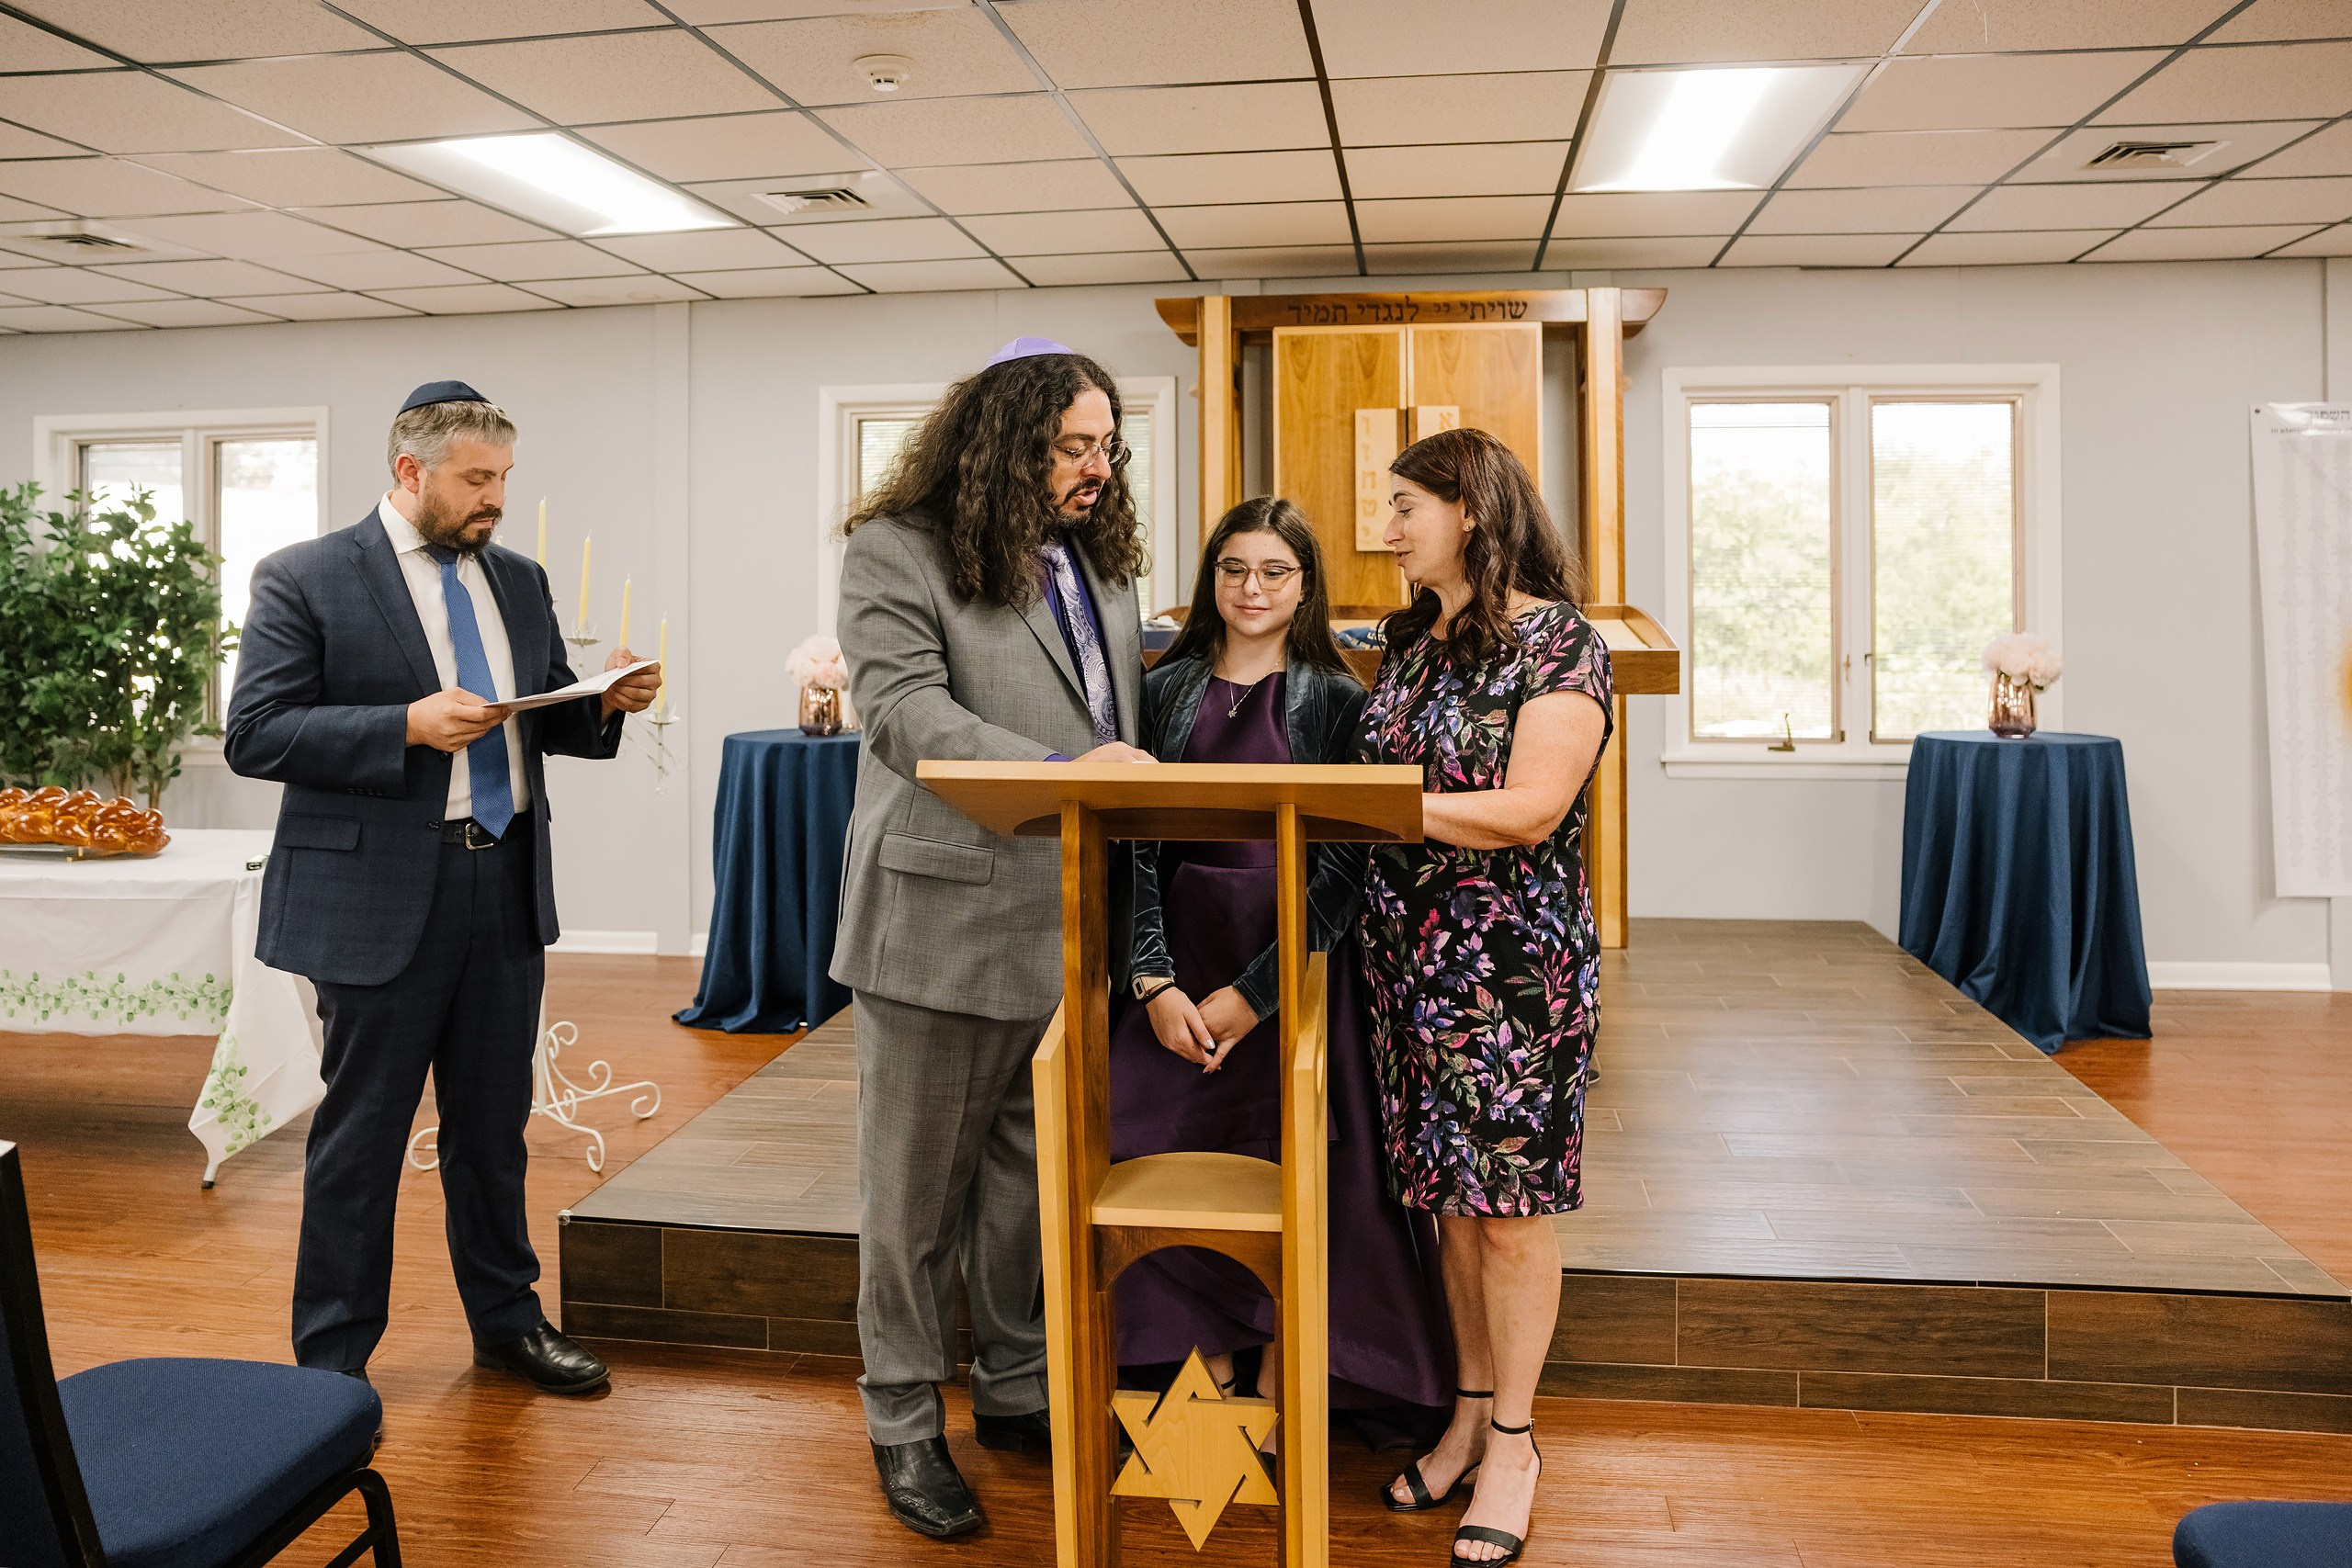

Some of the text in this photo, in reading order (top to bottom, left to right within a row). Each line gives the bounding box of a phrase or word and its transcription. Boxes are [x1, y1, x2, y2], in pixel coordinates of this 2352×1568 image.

[1287, 295, 1528, 323] שויתי יי לנגדי תמיד
